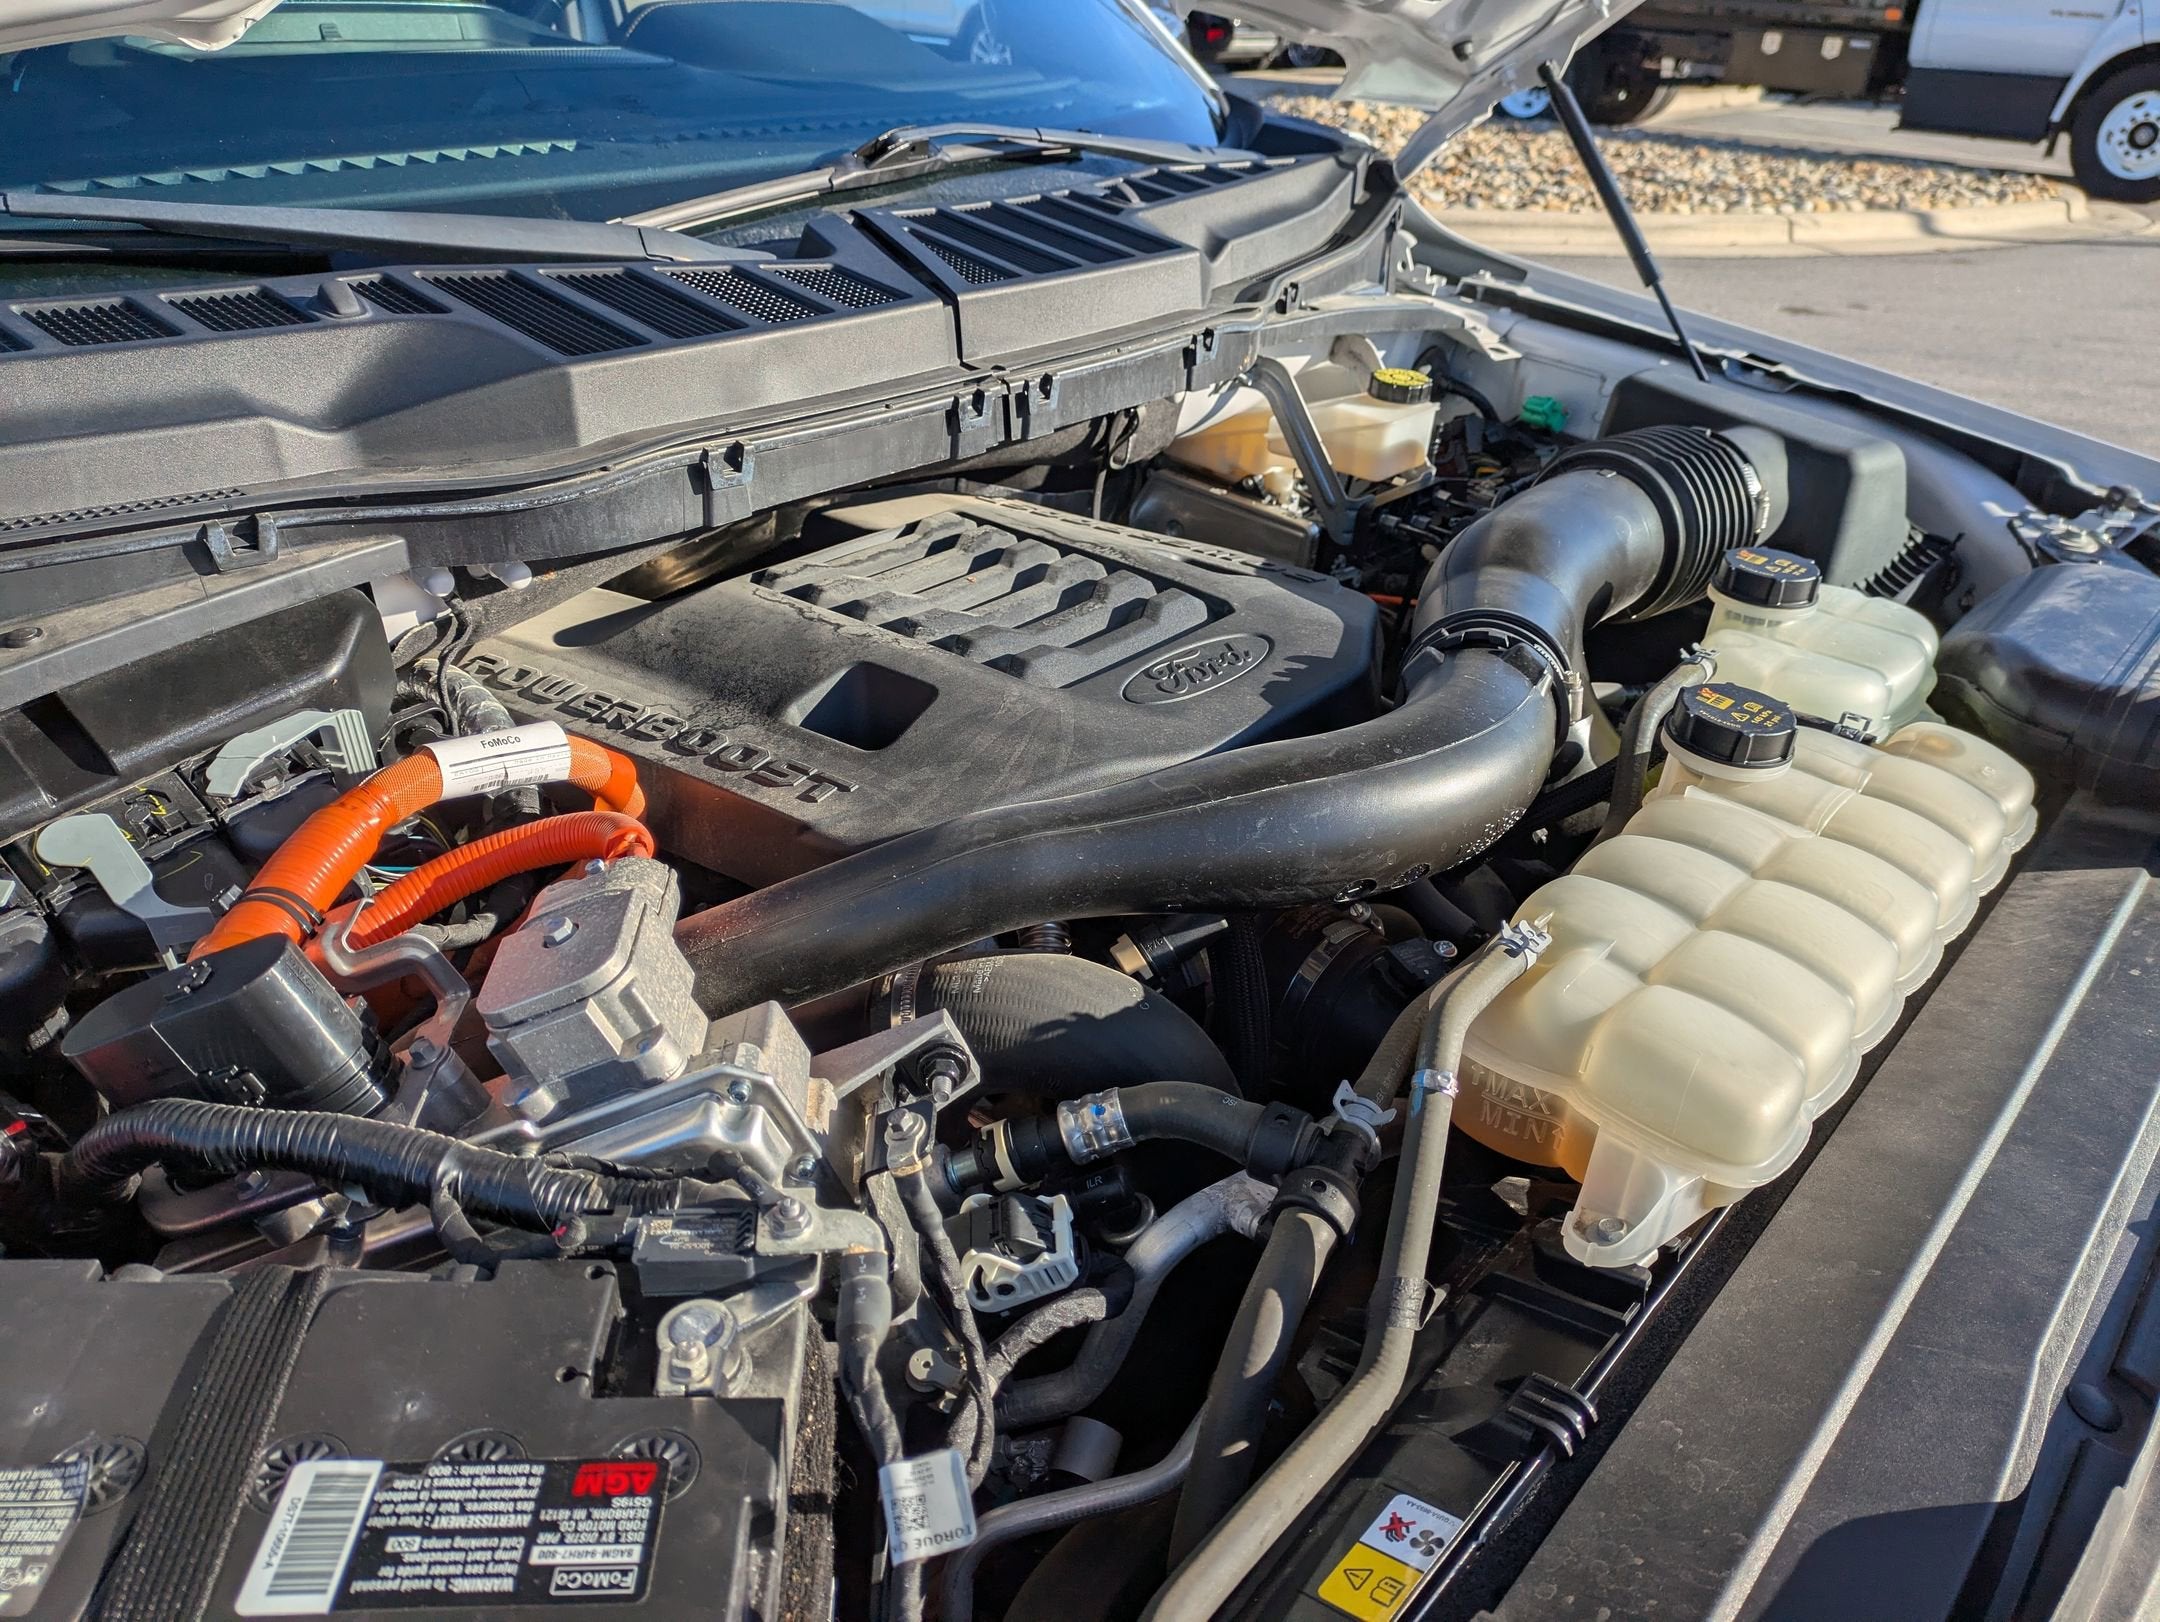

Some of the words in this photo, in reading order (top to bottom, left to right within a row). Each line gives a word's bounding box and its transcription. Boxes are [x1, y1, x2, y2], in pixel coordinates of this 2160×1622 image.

[1144, 643, 1252, 694] Ford
[464, 653, 859, 803] POWERBOOST
[480, 735, 521, 749] FoMoCo
[1486, 1071, 1551, 1115] MAX
[1480, 1100, 1547, 1144] MIN
[571, 1471, 656, 1496] AGM
[438, 1502, 460, 1513] Voir
[516, 1501, 535, 1512] des
[398, 1515, 423, 1527] Pour
[431, 1514, 531, 1528] AVERTISSEMENT
[539, 1509, 571, 1521] 48121
[558, 1520, 576, 1532] CO.
[577, 1520, 616, 1531] MOTOR
[618, 1519, 648, 1531] FORD
[422, 1536, 452, 1550] amps
[453, 1536, 499, 1550] cranking
[499, 1536, 525, 1549] Cold
[600, 1532, 616, 1543] BY
[913, 1525, 972, 1549] TORQUE
[466, 1551, 493, 1563] start
[494, 1549, 522, 1562] jump
[395, 1563, 428, 1577] guide
[429, 1564, 463, 1576] owner
[464, 1564, 485, 1575] see
[349, 1577, 401, 1594] personal
[401, 1578, 432, 1593] avoid
[448, 1576, 514, 1593] WARNING:
[556, 1571, 633, 1589] FoMoCo
